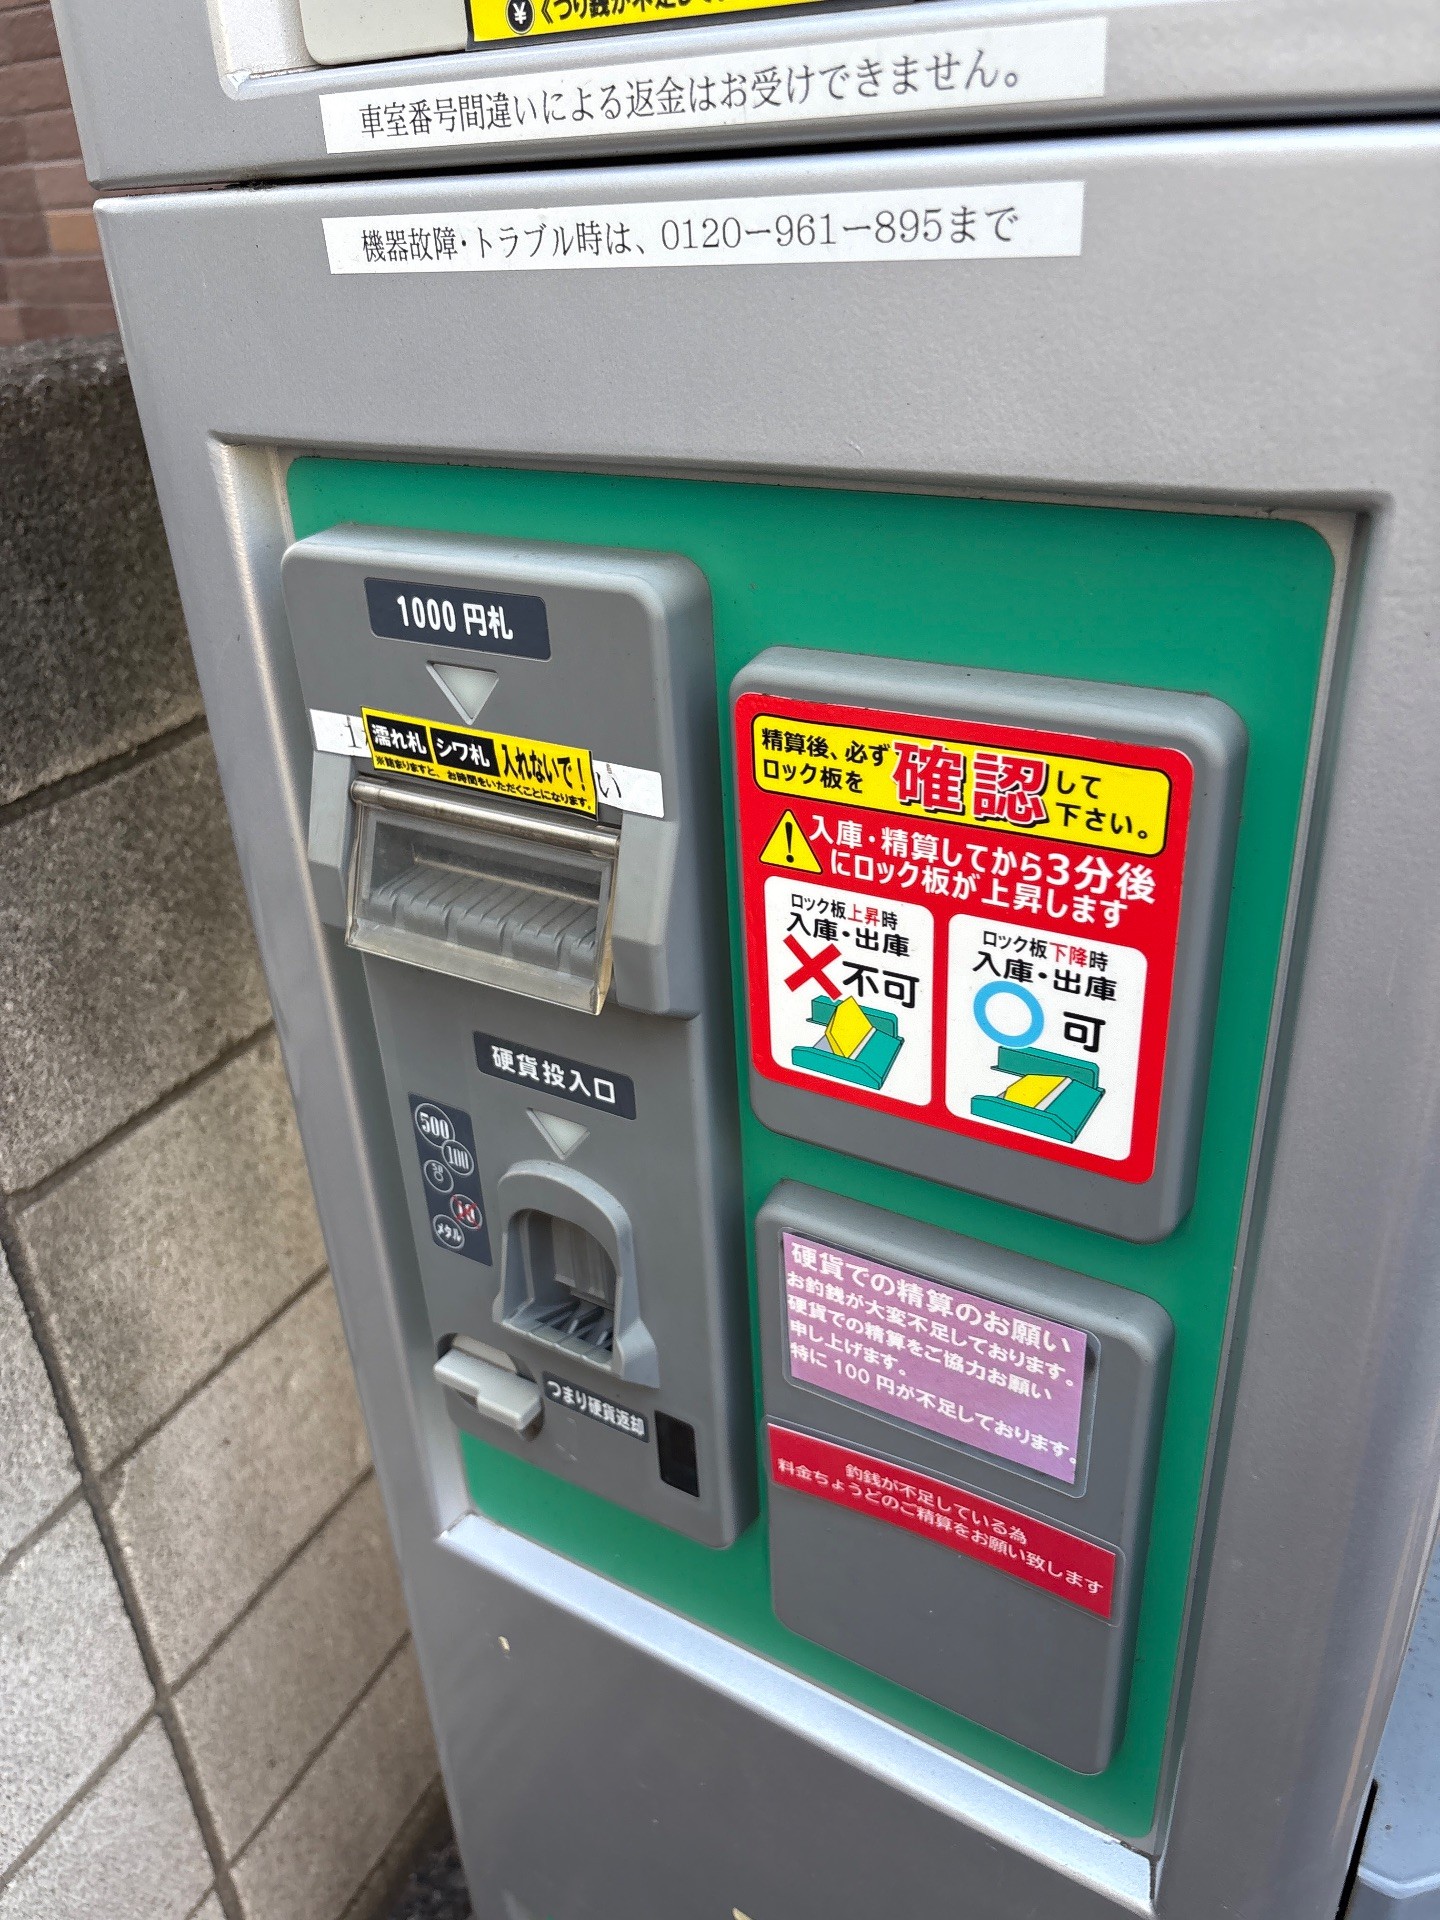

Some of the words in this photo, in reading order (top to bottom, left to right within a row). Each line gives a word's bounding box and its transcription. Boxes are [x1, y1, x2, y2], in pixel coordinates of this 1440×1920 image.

[358, 49, 1019, 139] 車室番号間違いによる返金はお受けできません。
[371, 723, 427, 756] 濡れ札
[436, 738, 491, 768] シワ札
[761, 727, 891, 767] 精算後、必ず
[763, 759, 864, 794] ロック板を
[890, 740, 1050, 828] 確認
[1056, 771, 1102, 800] して
[1055, 803, 1149, 840] 下さい。
[808, 813, 1157, 905] 入庫・精算してから3分後
[790, 892, 898, 931] ロック板上昇時
[829, 849, 1129, 930] にロック板が上昇します
[786, 913, 911, 958] 入庫・出庫
[982, 929, 1109, 973] ロック板下降時
[841, 959, 920, 1009] 不可
[972, 950, 1117, 1002] 入庫・出庫
[1062, 1010, 1106, 1054] 可
[491, 1045, 616, 1104] 硬貨投入口
[419, 1111, 451, 1141] 500
[446, 1145, 470, 1171] 100
[791, 1241, 1072, 1354] 硬貨での精算のお願い
[786, 1270, 1075, 1388] お釣銭が大変不足しております。
[787, 1293, 1053, 1401] 硬貨での精算をご協力お願い
[789, 1319, 907, 1377] 申し上げます。
[546, 1380, 646, 1437] つまり硬貨返却
[777, 1457, 1105, 1596] 料金ちょうどのご精算をお願い致します
[844, 1462, 1028, 1546] 釣銭が不足している為
